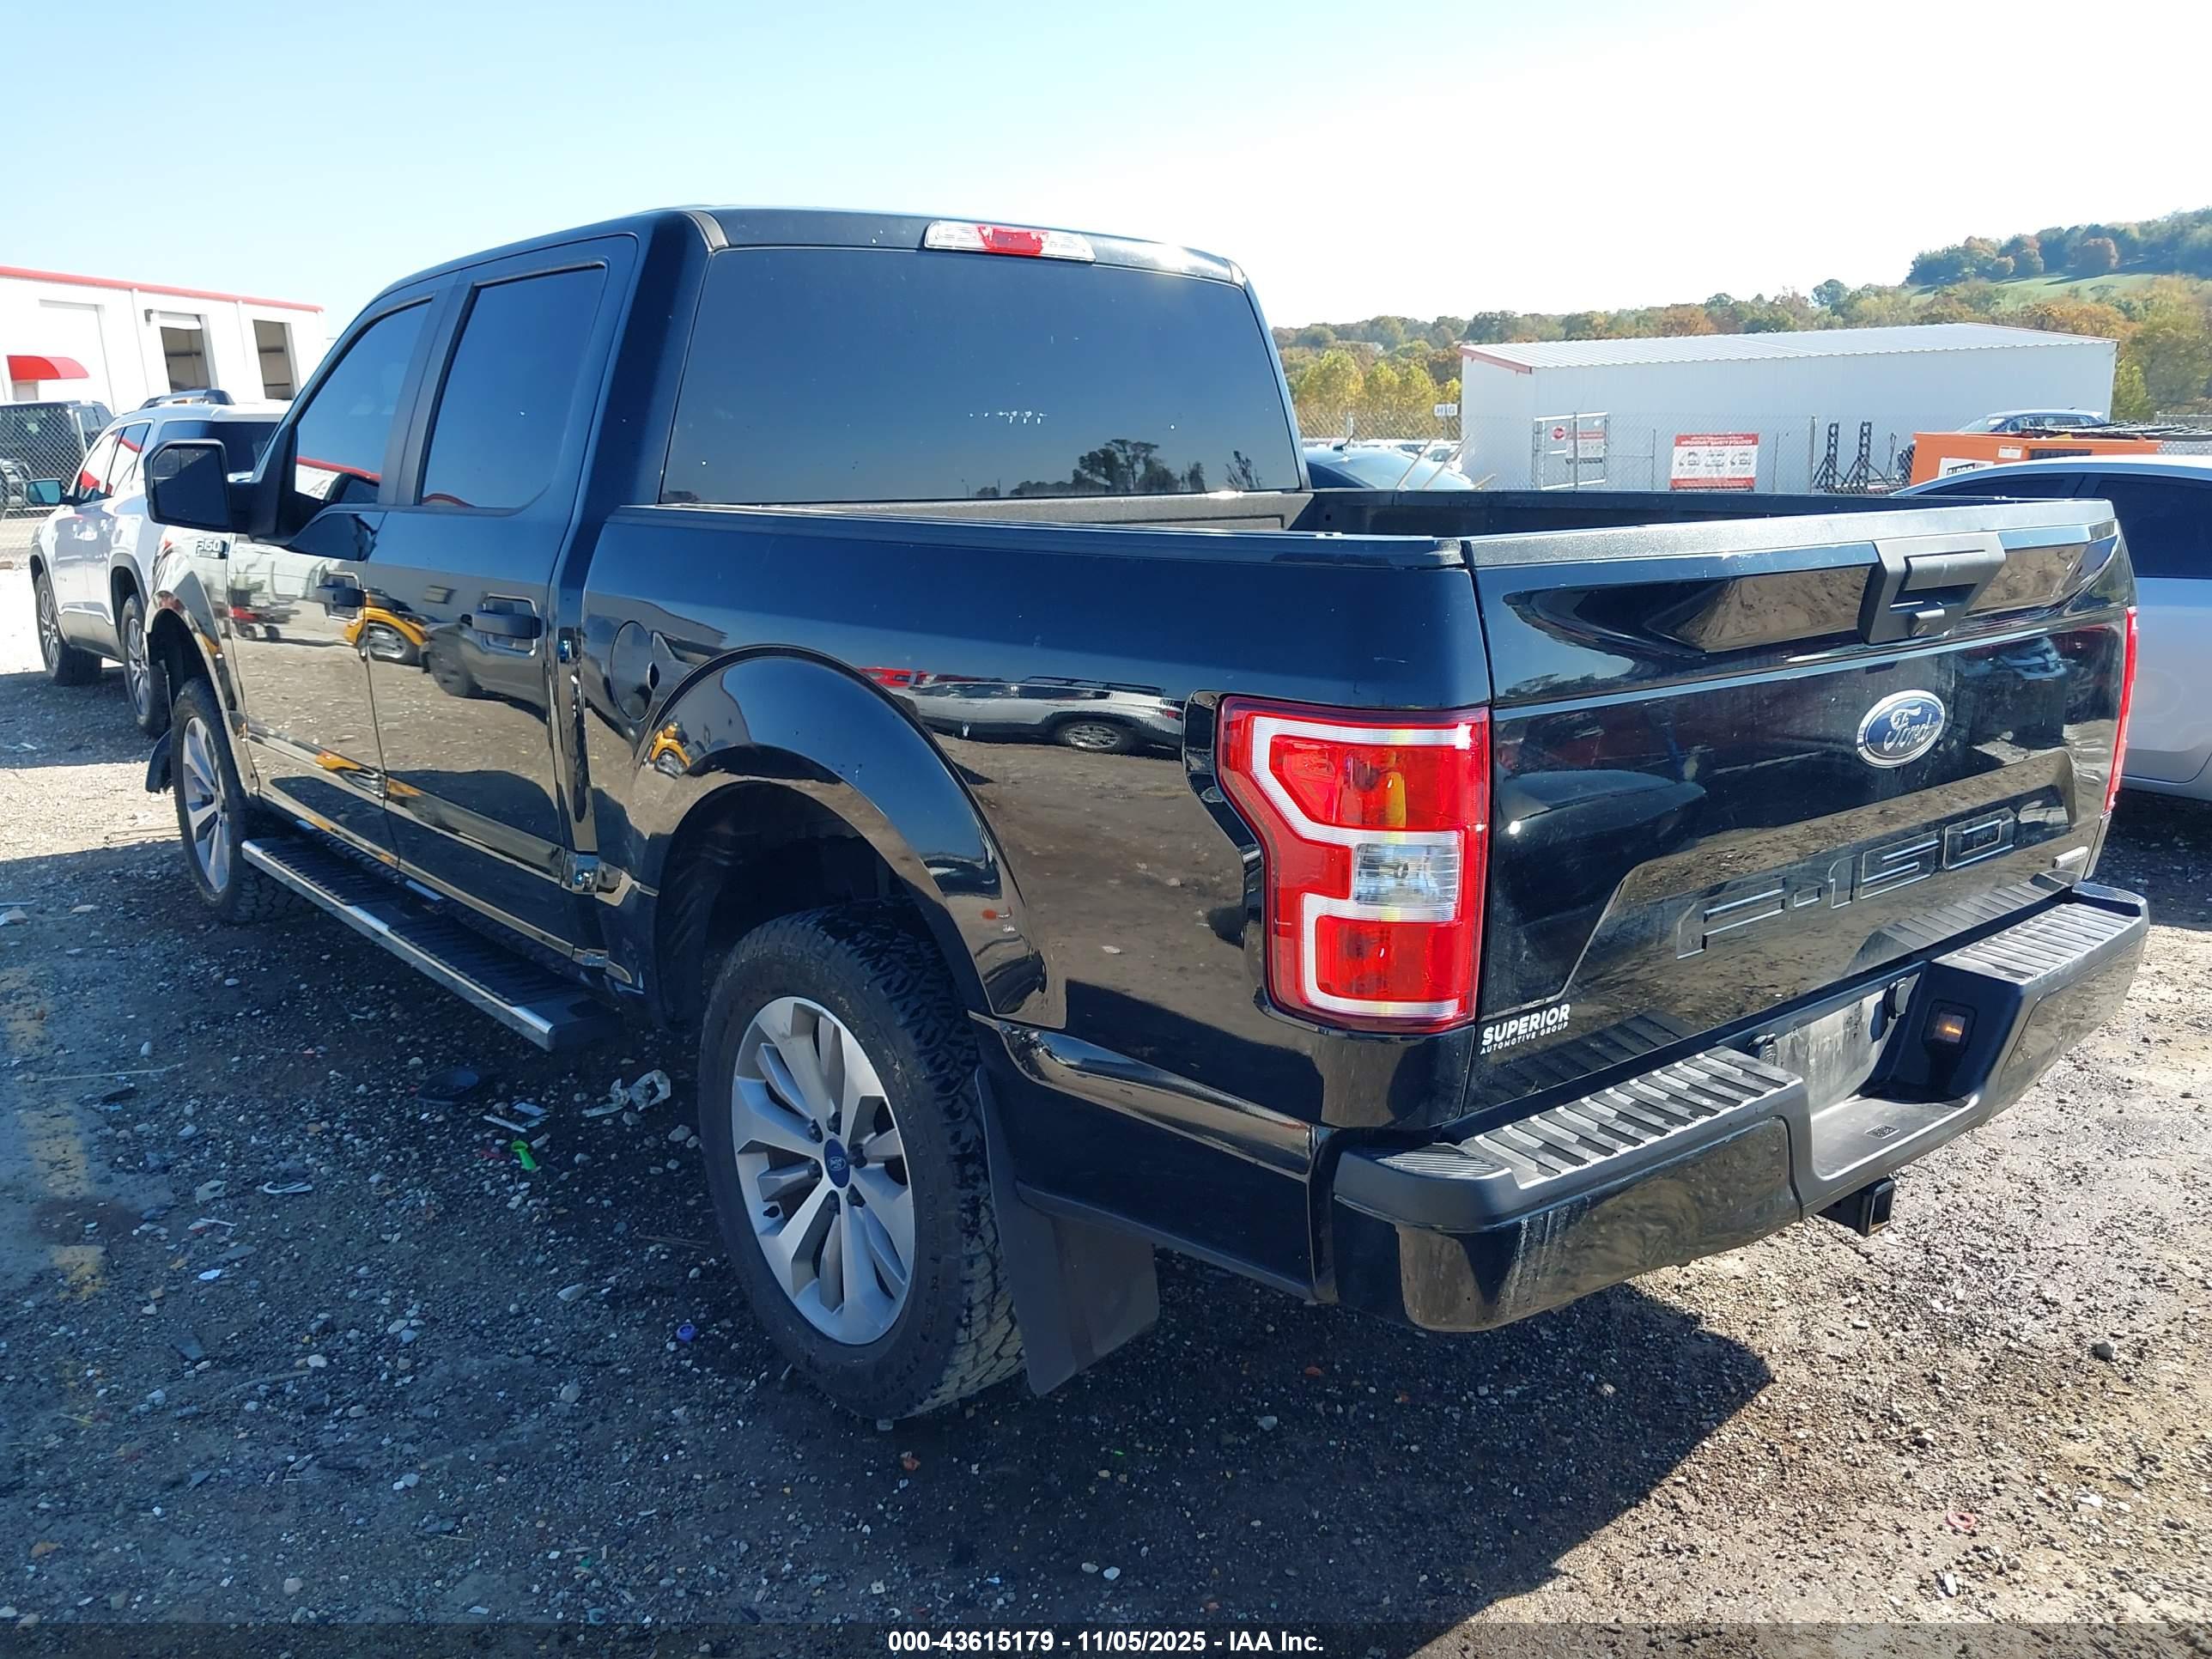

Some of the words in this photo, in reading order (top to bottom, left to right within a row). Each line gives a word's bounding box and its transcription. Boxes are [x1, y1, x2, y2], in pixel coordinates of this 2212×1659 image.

[1883, 706, 1932, 751] Ford
[1674, 807, 2016, 960] F-150
[1480, 1031, 1536, 1055] AUTOMOTIVE
[1540, 1021, 1568, 1036] GROUP
[1481, 1003, 1571, 1046] SUPERIOR
